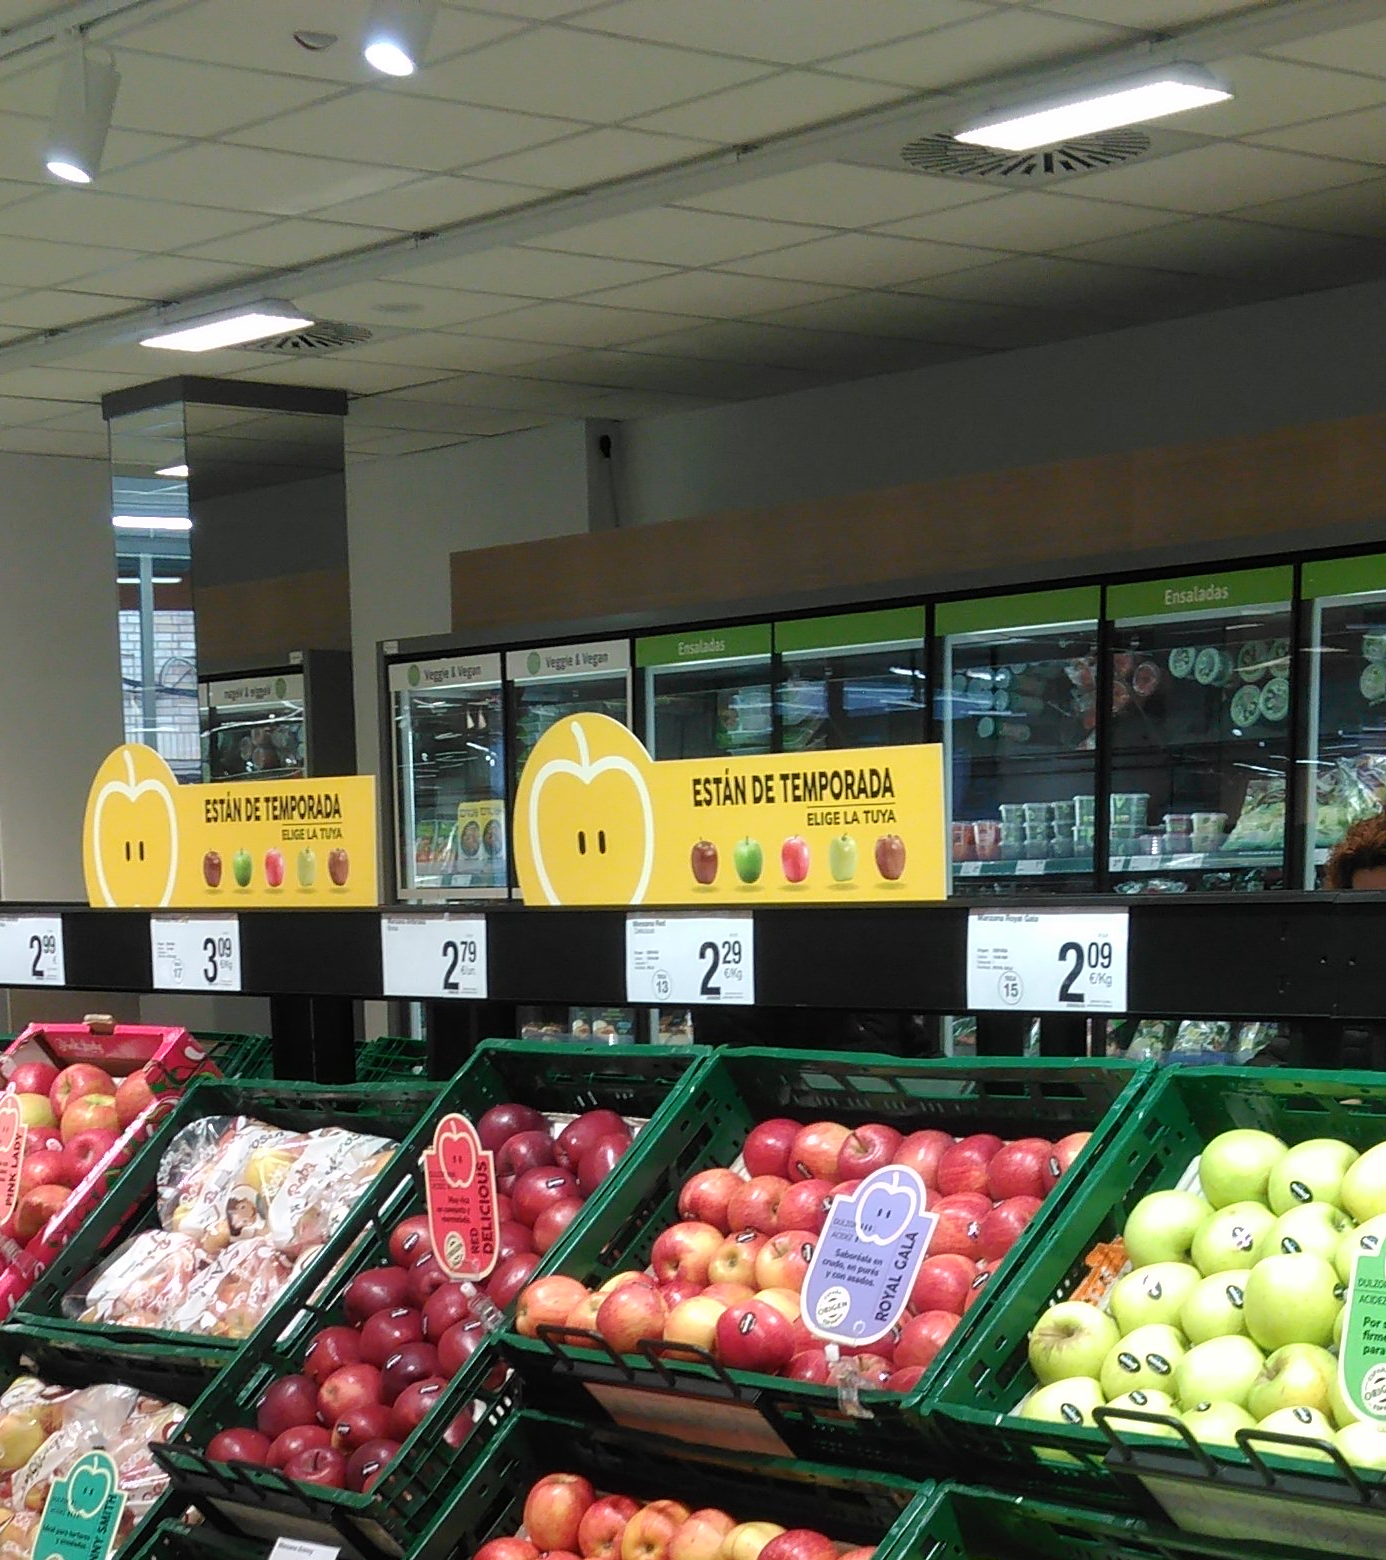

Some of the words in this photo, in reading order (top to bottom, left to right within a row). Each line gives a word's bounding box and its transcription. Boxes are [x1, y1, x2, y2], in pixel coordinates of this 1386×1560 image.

[1164, 583, 1229, 606] Ensaladas
[678, 639, 726, 656] Ensaladas
[424, 669, 449, 683] Veggie
[458, 665, 481, 679] Vegan
[545, 658, 573, 672] Veggie
[583, 653, 608, 668] Vegan
[692, 768, 746, 809] ESTÁN
[752, 774, 775, 805] DE
[778, 767, 896, 803] TEMPORADA
[205, 790, 240, 824] ESTÁN
[245, 798, 262, 822] DE
[264, 793, 342, 822] TEMPORADA
[807, 812, 842, 828] ELIGE
[844, 811, 859, 825] LA
[862, 809, 896, 826] TUYA
[282, 828, 305, 842] ELIGE
[306, 828, 318, 841] LA
[320, 826, 343, 840] TUYA
[29, 934, 44, 977] 2
[203, 937, 217, 983] 3
[218, 937, 232, 958] 09
[442, 940, 459, 990] 2
[460, 941, 477, 963] 79
[699, 941, 721, 996] 2
[722, 940, 742, 965] 29
[1058, 941, 1085, 1003] 2
[1088, 941, 1112, 969] 09
[1089, 972, 1113, 987] €/Kg
[1003, 983, 1019, 998] 15
[11, 1133, 23, 1168] LADY
[476, 1161, 494, 1254] DELICIOUS
[832, 1271, 845, 1280] con
[875, 1276, 902, 1323] ROYAL
[894, 1231, 919, 1271] GALA
[1363, 1316, 1381, 1328] Por
[1363, 1346, 1386, 1358] para
[98, 1494, 118, 1534] SMITH
